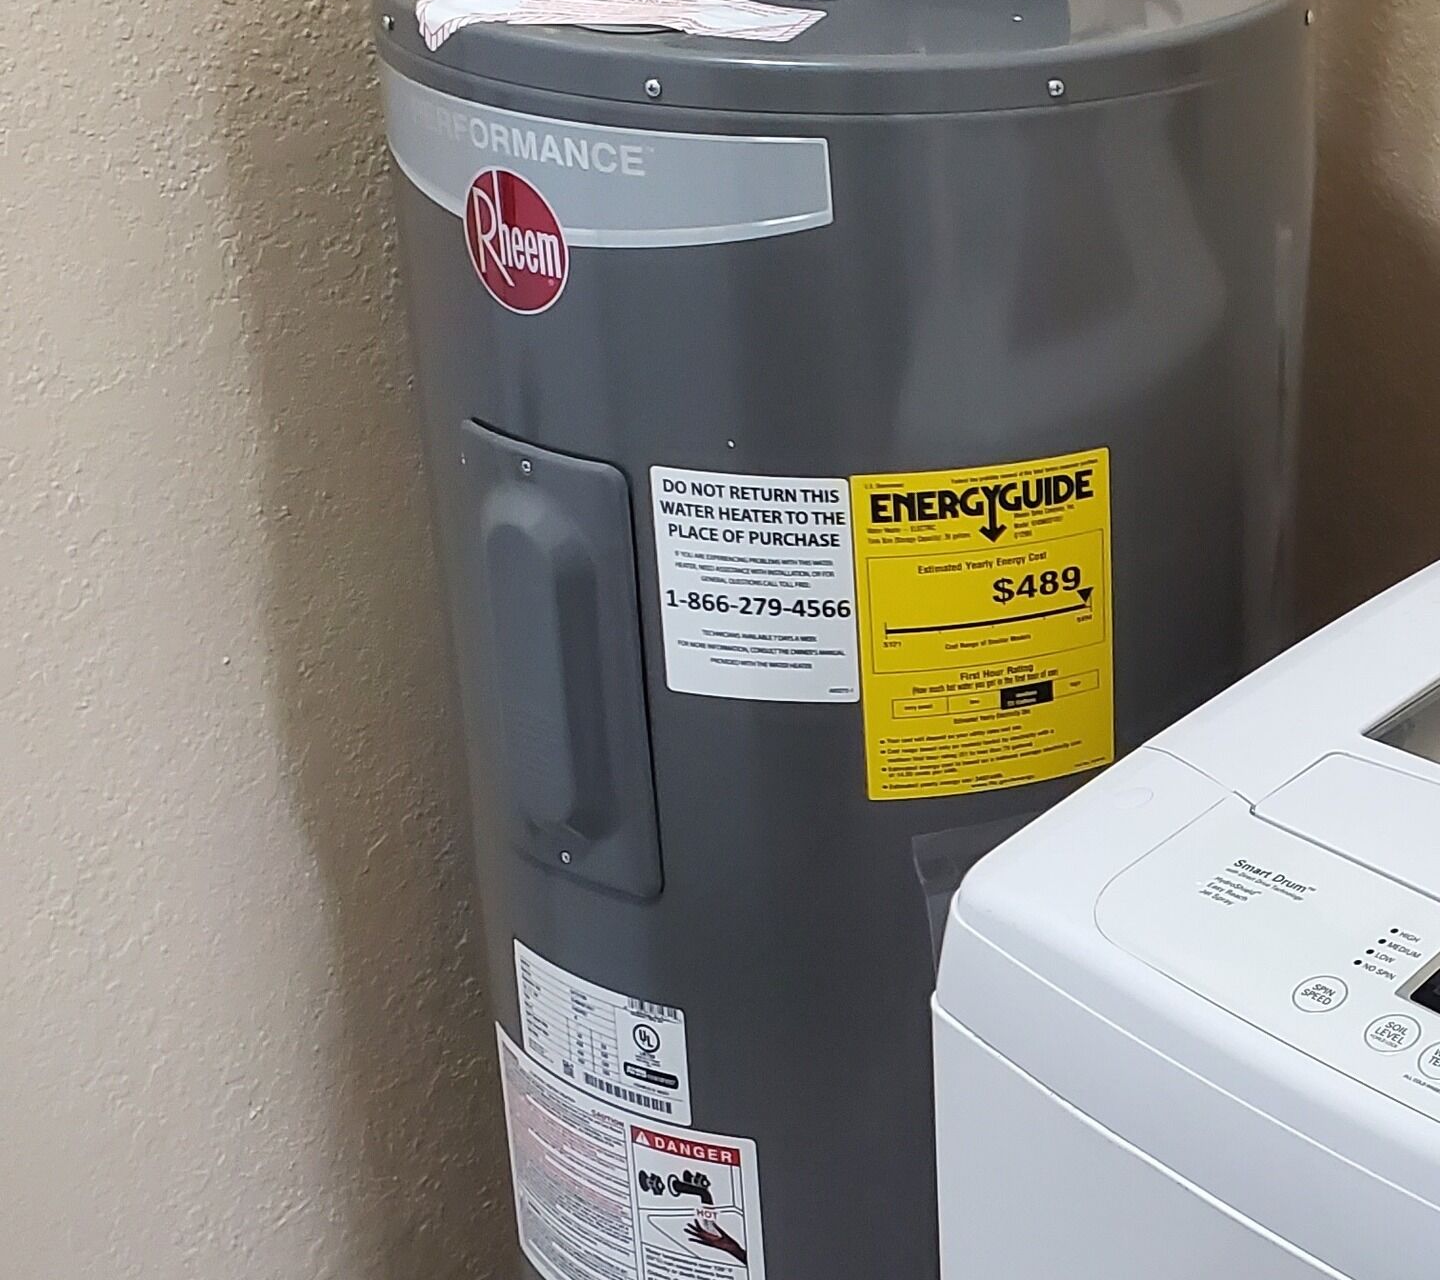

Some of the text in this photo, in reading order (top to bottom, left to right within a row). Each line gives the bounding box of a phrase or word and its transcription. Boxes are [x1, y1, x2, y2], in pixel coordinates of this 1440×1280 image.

[413, 106, 646, 176] ERFORMANCE
[472, 170, 562, 287] Rheem
[662, 478, 840, 504] DO NOT RETURN THIS
[870, 469, 1094, 524] ENERGYGUIDE
[660, 500, 847, 526] WATER HEATER TO THE
[668, 523, 841, 547] PLACE OF PURCHASE
[917, 551, 1047, 574] Estimated Yearly Energy Cost
[992, 566, 1081, 605] $489
[666, 589, 851, 618] 1-866-279-4566
[960, 664, 1034, 681] First Hour Rating
[1234, 859, 1272, 878] Smart
[1206, 882, 1248, 901] Easy Reach
[1399, 932, 1421, 942] HIGH
[1374, 952, 1396, 963] LOW
[1388, 942, 1422, 958] MEDIUM
[1363, 963, 1396, 980] NO SPIN
[1300, 988, 1333, 1006] SPEED
[1312, 983, 1336, 998] SPIN
[1374, 1027, 1404, 1045] LEVEL
[1385, 1021, 1408, 1036] SOIL
[639, 1029, 654, 1048] UL
[654, 1137, 733, 1163] DANGER
[696, 1208, 718, 1220] HOT
